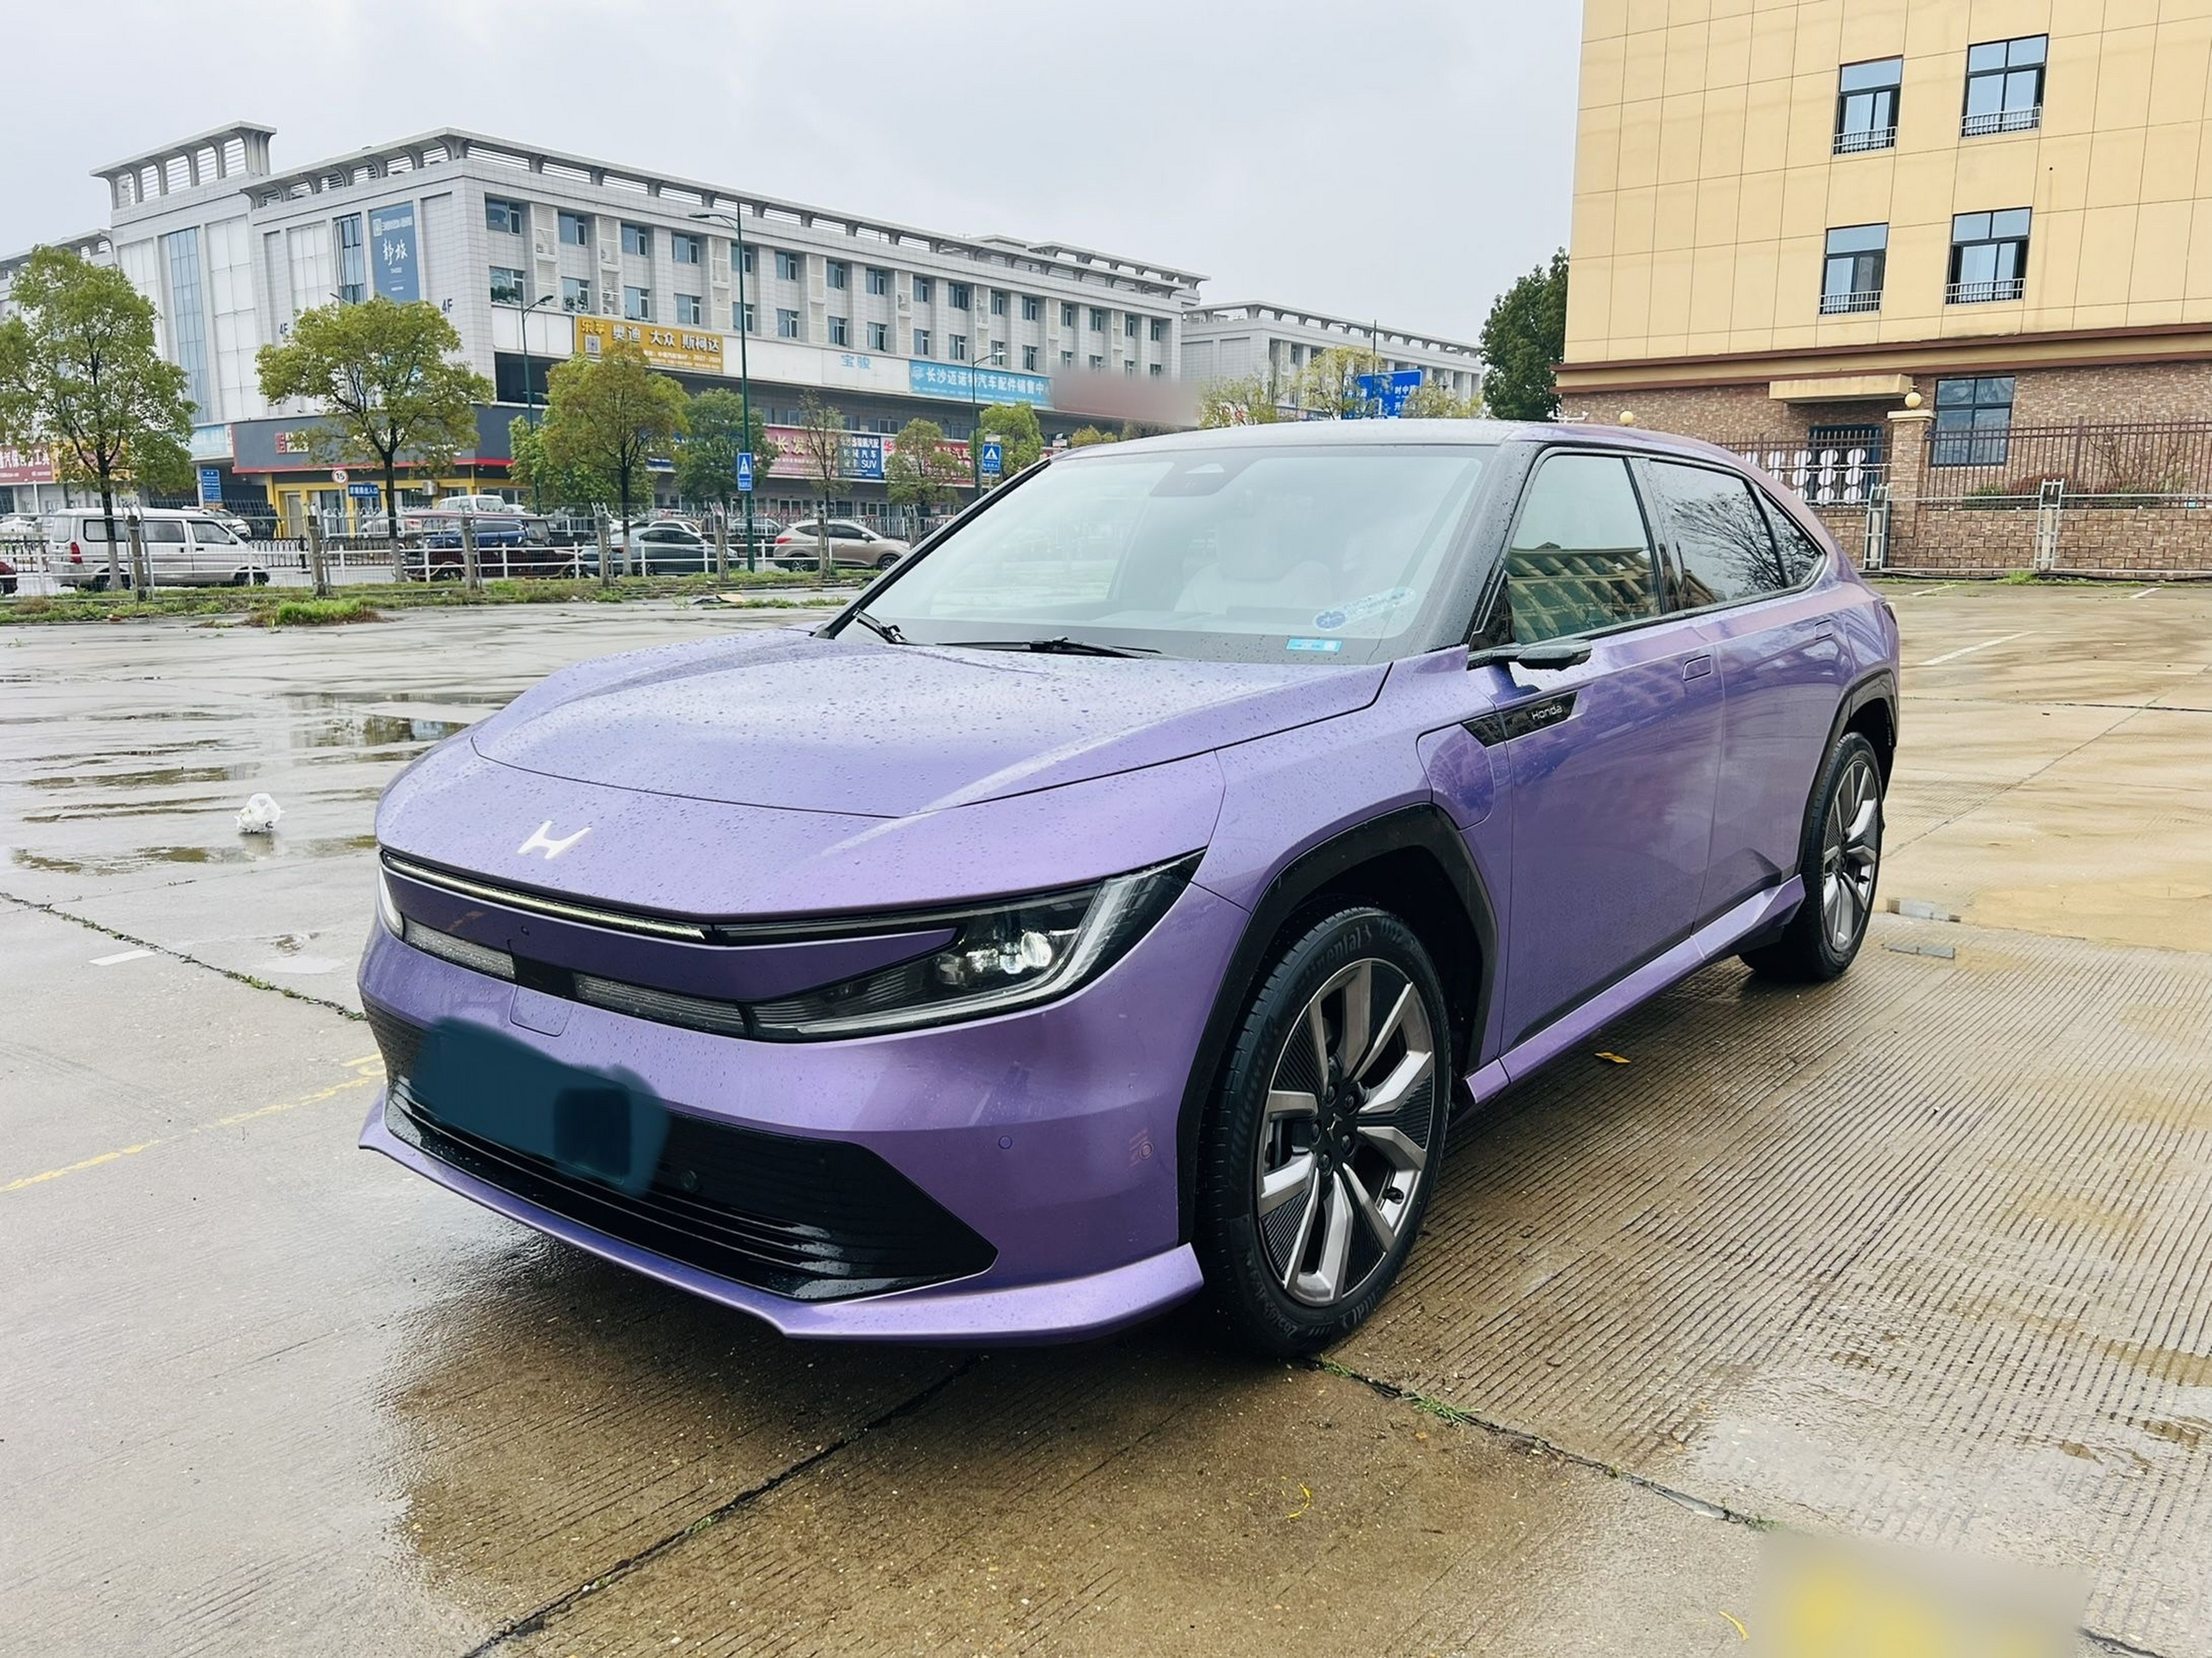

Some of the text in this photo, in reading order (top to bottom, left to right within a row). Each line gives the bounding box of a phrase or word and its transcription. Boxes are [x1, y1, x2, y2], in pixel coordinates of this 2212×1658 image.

[441, 298, 453, 314] 4F
[279, 323, 288, 335] 4F
[613, 324, 641, 342] 奥迪
[650, 330, 676, 347] 大众
[682, 334, 719, 353] 斯柯达
[840, 354, 871, 370] 宝骏
[861, 459, 877, 469] SUV
[1531, 705, 1563, 721] Honda
